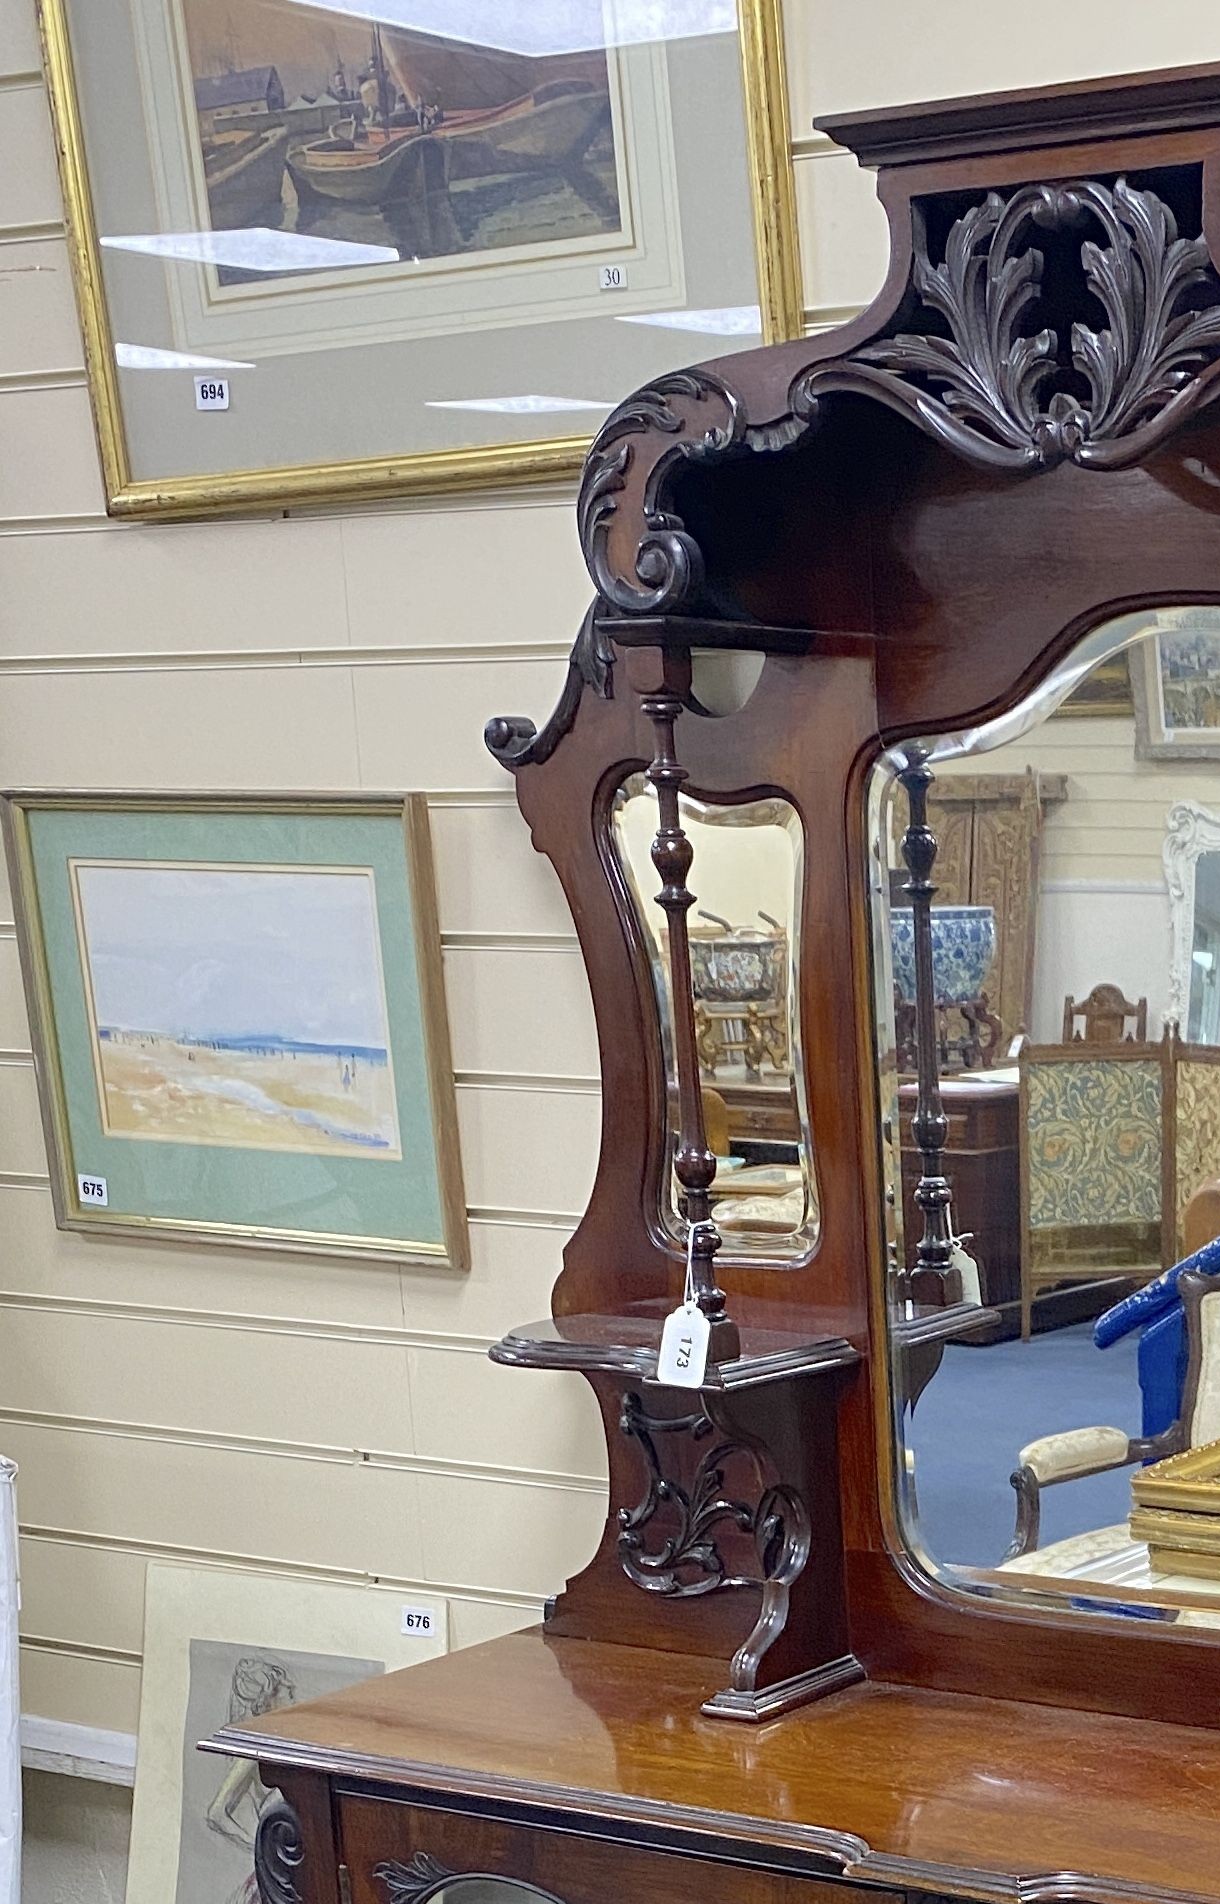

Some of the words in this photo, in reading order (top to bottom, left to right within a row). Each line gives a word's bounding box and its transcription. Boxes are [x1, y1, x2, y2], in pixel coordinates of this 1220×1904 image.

[604, 267, 620, 286] 30
[201, 384, 224, 400] 694
[83, 1181, 103, 1197] 675
[676, 1337, 692, 1368] 173
[407, 1614, 431, 1629] 676
